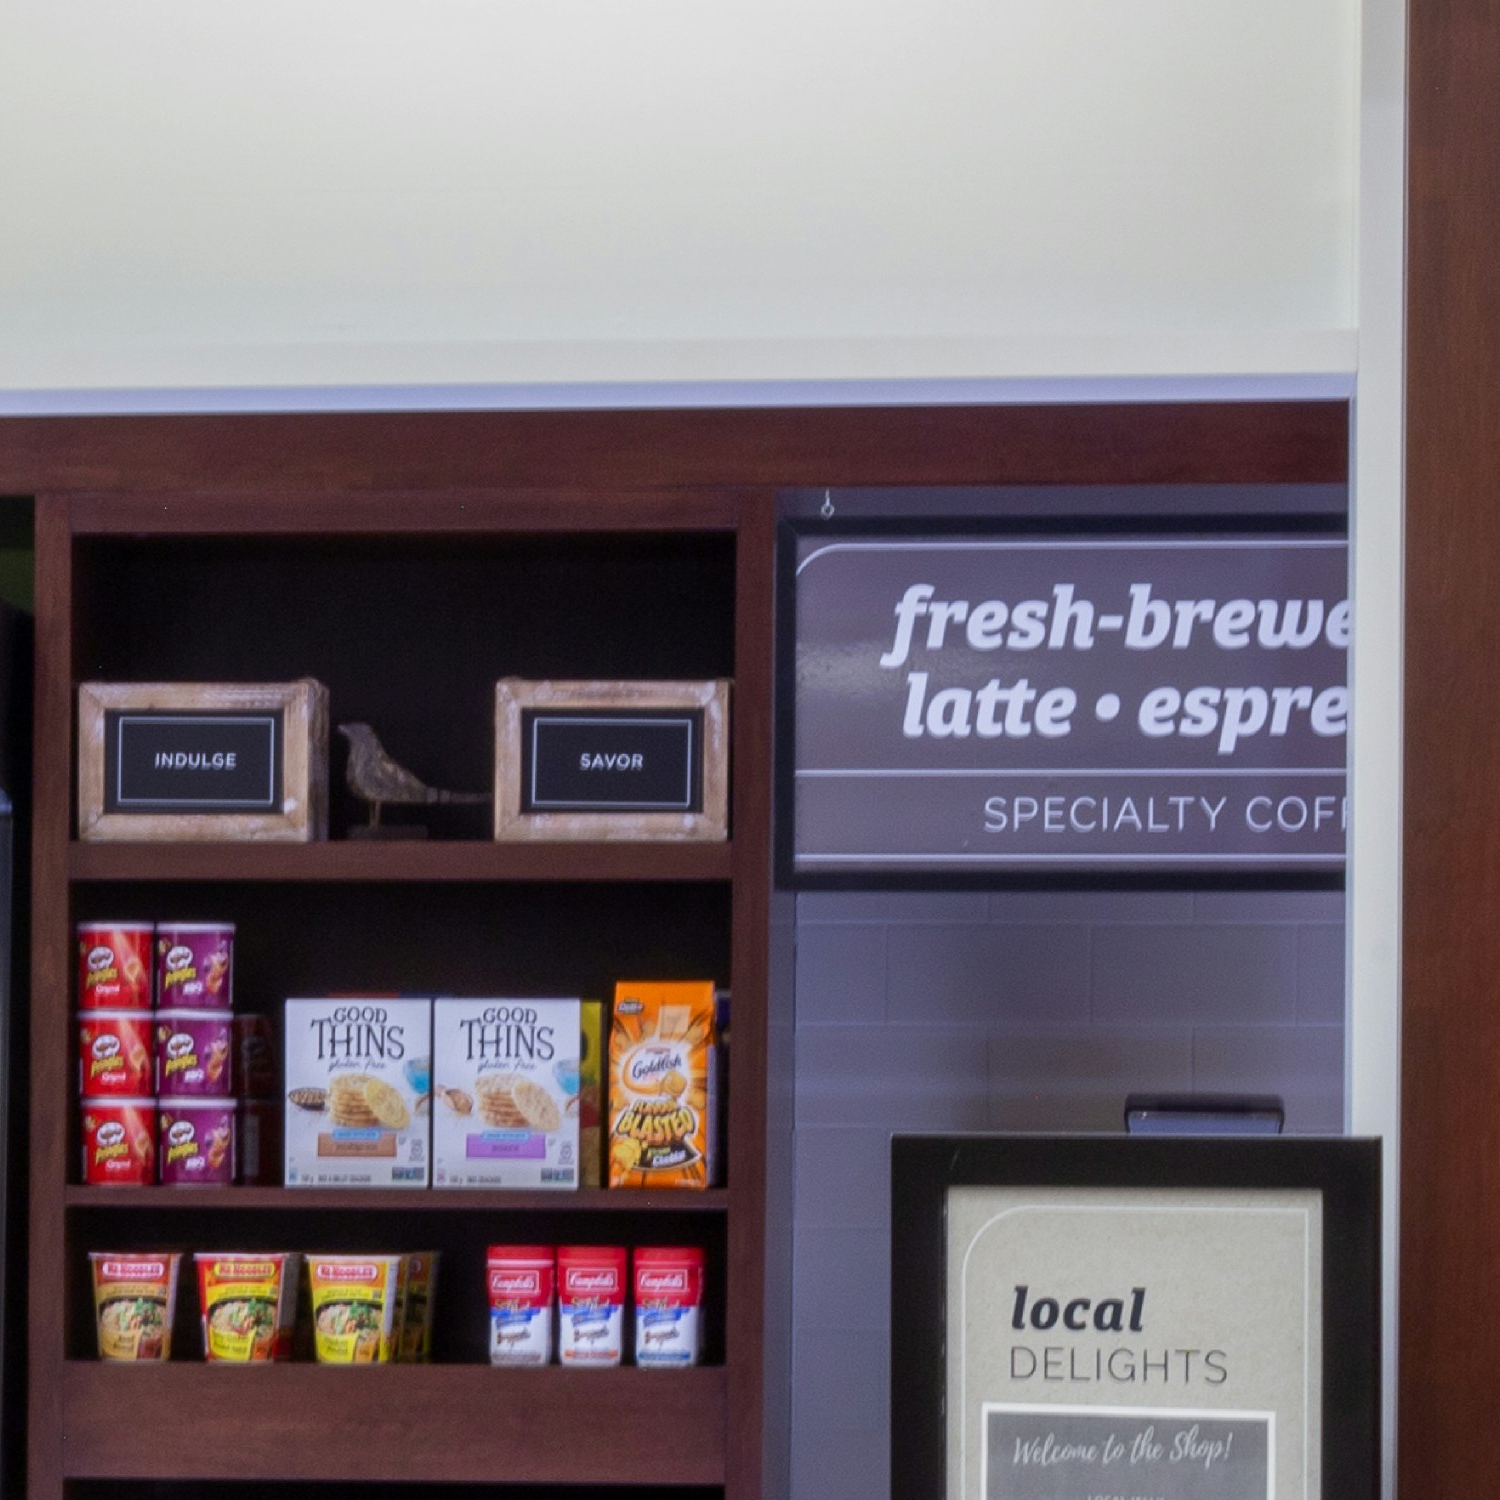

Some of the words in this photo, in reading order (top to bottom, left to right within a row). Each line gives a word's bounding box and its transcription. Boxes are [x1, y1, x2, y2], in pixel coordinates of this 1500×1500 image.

[880, 583, 1350, 668] fresh-brewe
[903, 672, 1076, 738] latte
[1139, 686, 1349, 754] espre
[154, 752, 238, 771] INDULGE
[579, 752, 644, 771] SAVOR
[984, 796, 1227, 833] SPECIALTY
[1246, 796, 1348, 833] COF
[334, 1006, 388, 1024] GOOD
[482, 1007, 538, 1025] GOOD
[311, 1017, 405, 1061] THINS
[460, 1018, 555, 1061] THINS
[1010, 1286, 1146, 1332] local
[1010, 1346, 1228, 1385] DELIGHTS
[1012, 1431, 1099, 1467] Welcome
[1102, 1433, 1125, 1465] to
[1129, 1425, 1164, 1465] the
[1169, 1423, 1234, 1470] Shop!
